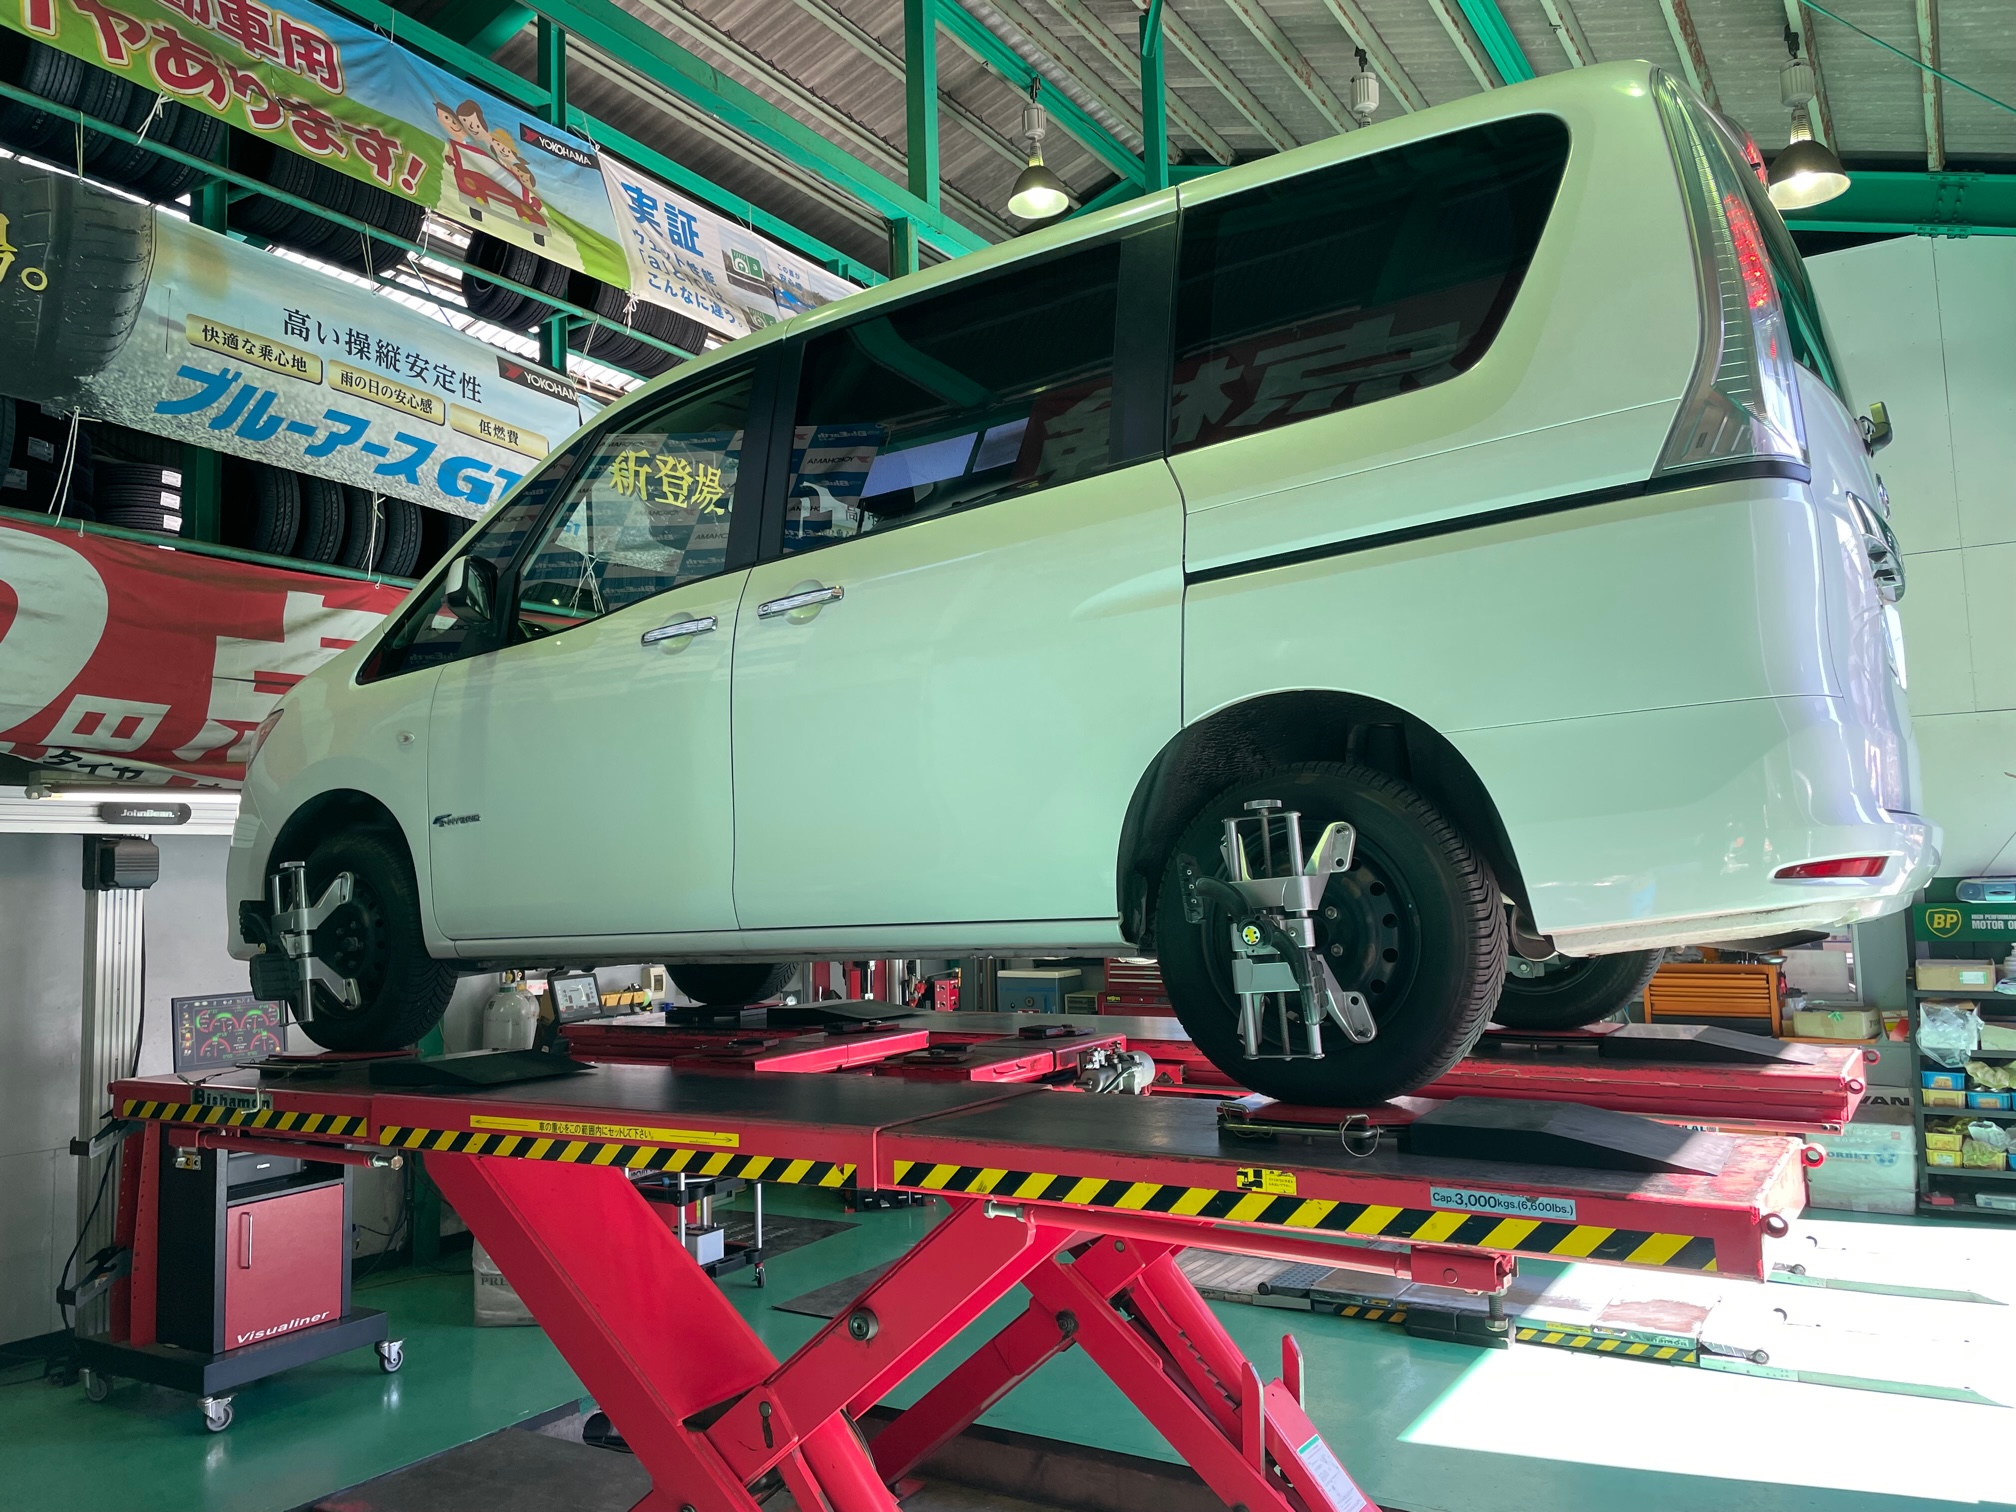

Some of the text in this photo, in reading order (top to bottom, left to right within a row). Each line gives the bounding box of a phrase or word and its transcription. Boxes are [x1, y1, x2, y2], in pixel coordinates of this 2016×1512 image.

[538, 136, 592, 165] YOKOHAMA
[621, 181, 704, 258] 実証
[201, 325, 307, 373] 快適な乗心地
[283, 308, 482, 404] 高い操縦安定性
[340, 369, 433, 414] 雨の日の安心感
[479, 418, 519, 447] 低燃費
[608, 449, 725, 516] 新登場
[1933, 914, 1957, 928] BP
[1971, 921, 2004, 930] MOTOR
[237, 1311, 330, 1344] Visualiner
